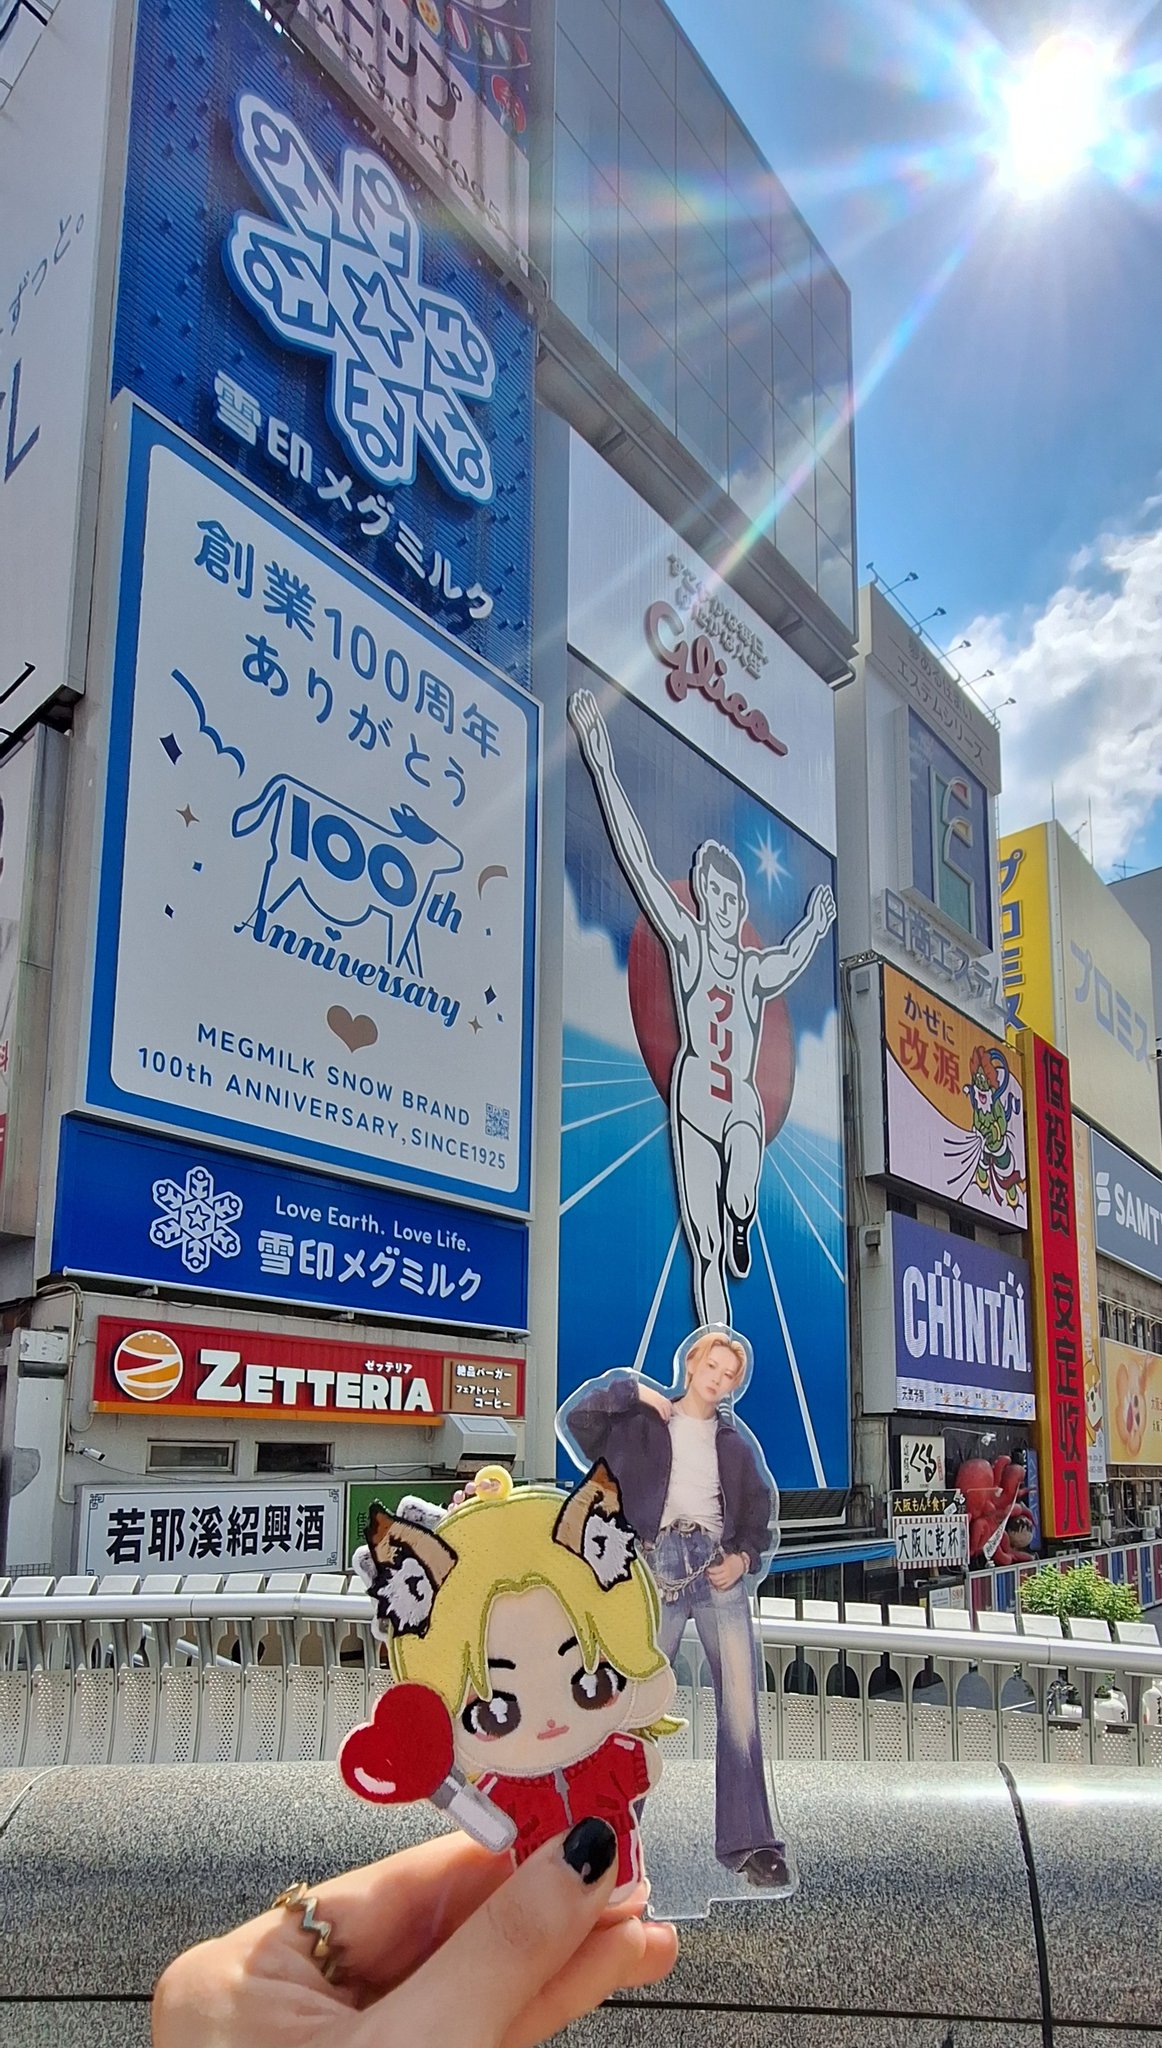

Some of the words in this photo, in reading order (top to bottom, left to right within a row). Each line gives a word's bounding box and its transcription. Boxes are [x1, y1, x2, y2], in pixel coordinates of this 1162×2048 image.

[214, 369, 494, 619] 雪印メグミルク
[194, 519, 501, 760] 創業100周年
[644, 600, 788, 757] Glico
[241, 633, 467, 808] ありがとう
[233, 907, 461, 1028] Anniversary
[904, 991, 955, 1046] かぜに
[1070, 939, 1153, 1076] プロミス
[138, 1047, 212, 1087] 100th
[198, 1023, 315, 1079] MEGMILK
[327, 1065, 393, 1102] SNOW
[402, 1090, 470, 1126] BRAND
[706, 983, 736, 1105] グリコ
[898, 1020, 961, 1095] 改源
[275, 1194, 322, 1222] Love
[328, 1206, 386, 1236] Earth.
[393, 1220, 433, 1245] Love
[437, 1229, 471, 1252] Life.
[1114, 1183, 1162, 1246] SAMT
[258, 1229, 482, 1302] 雪印メグミルク
[196, 1348, 434, 1413] ZETTERIA
[365, 1360, 413, 1375] ゼッテリア
[456, 1364, 513, 1380] 絶品バーガー
[474, 1397, 512, 1410] コーヒー
[105, 1503, 325, 1565] 若耶溪紹興酒
[898, 1524, 959, 1560] 大阪に乾杯
